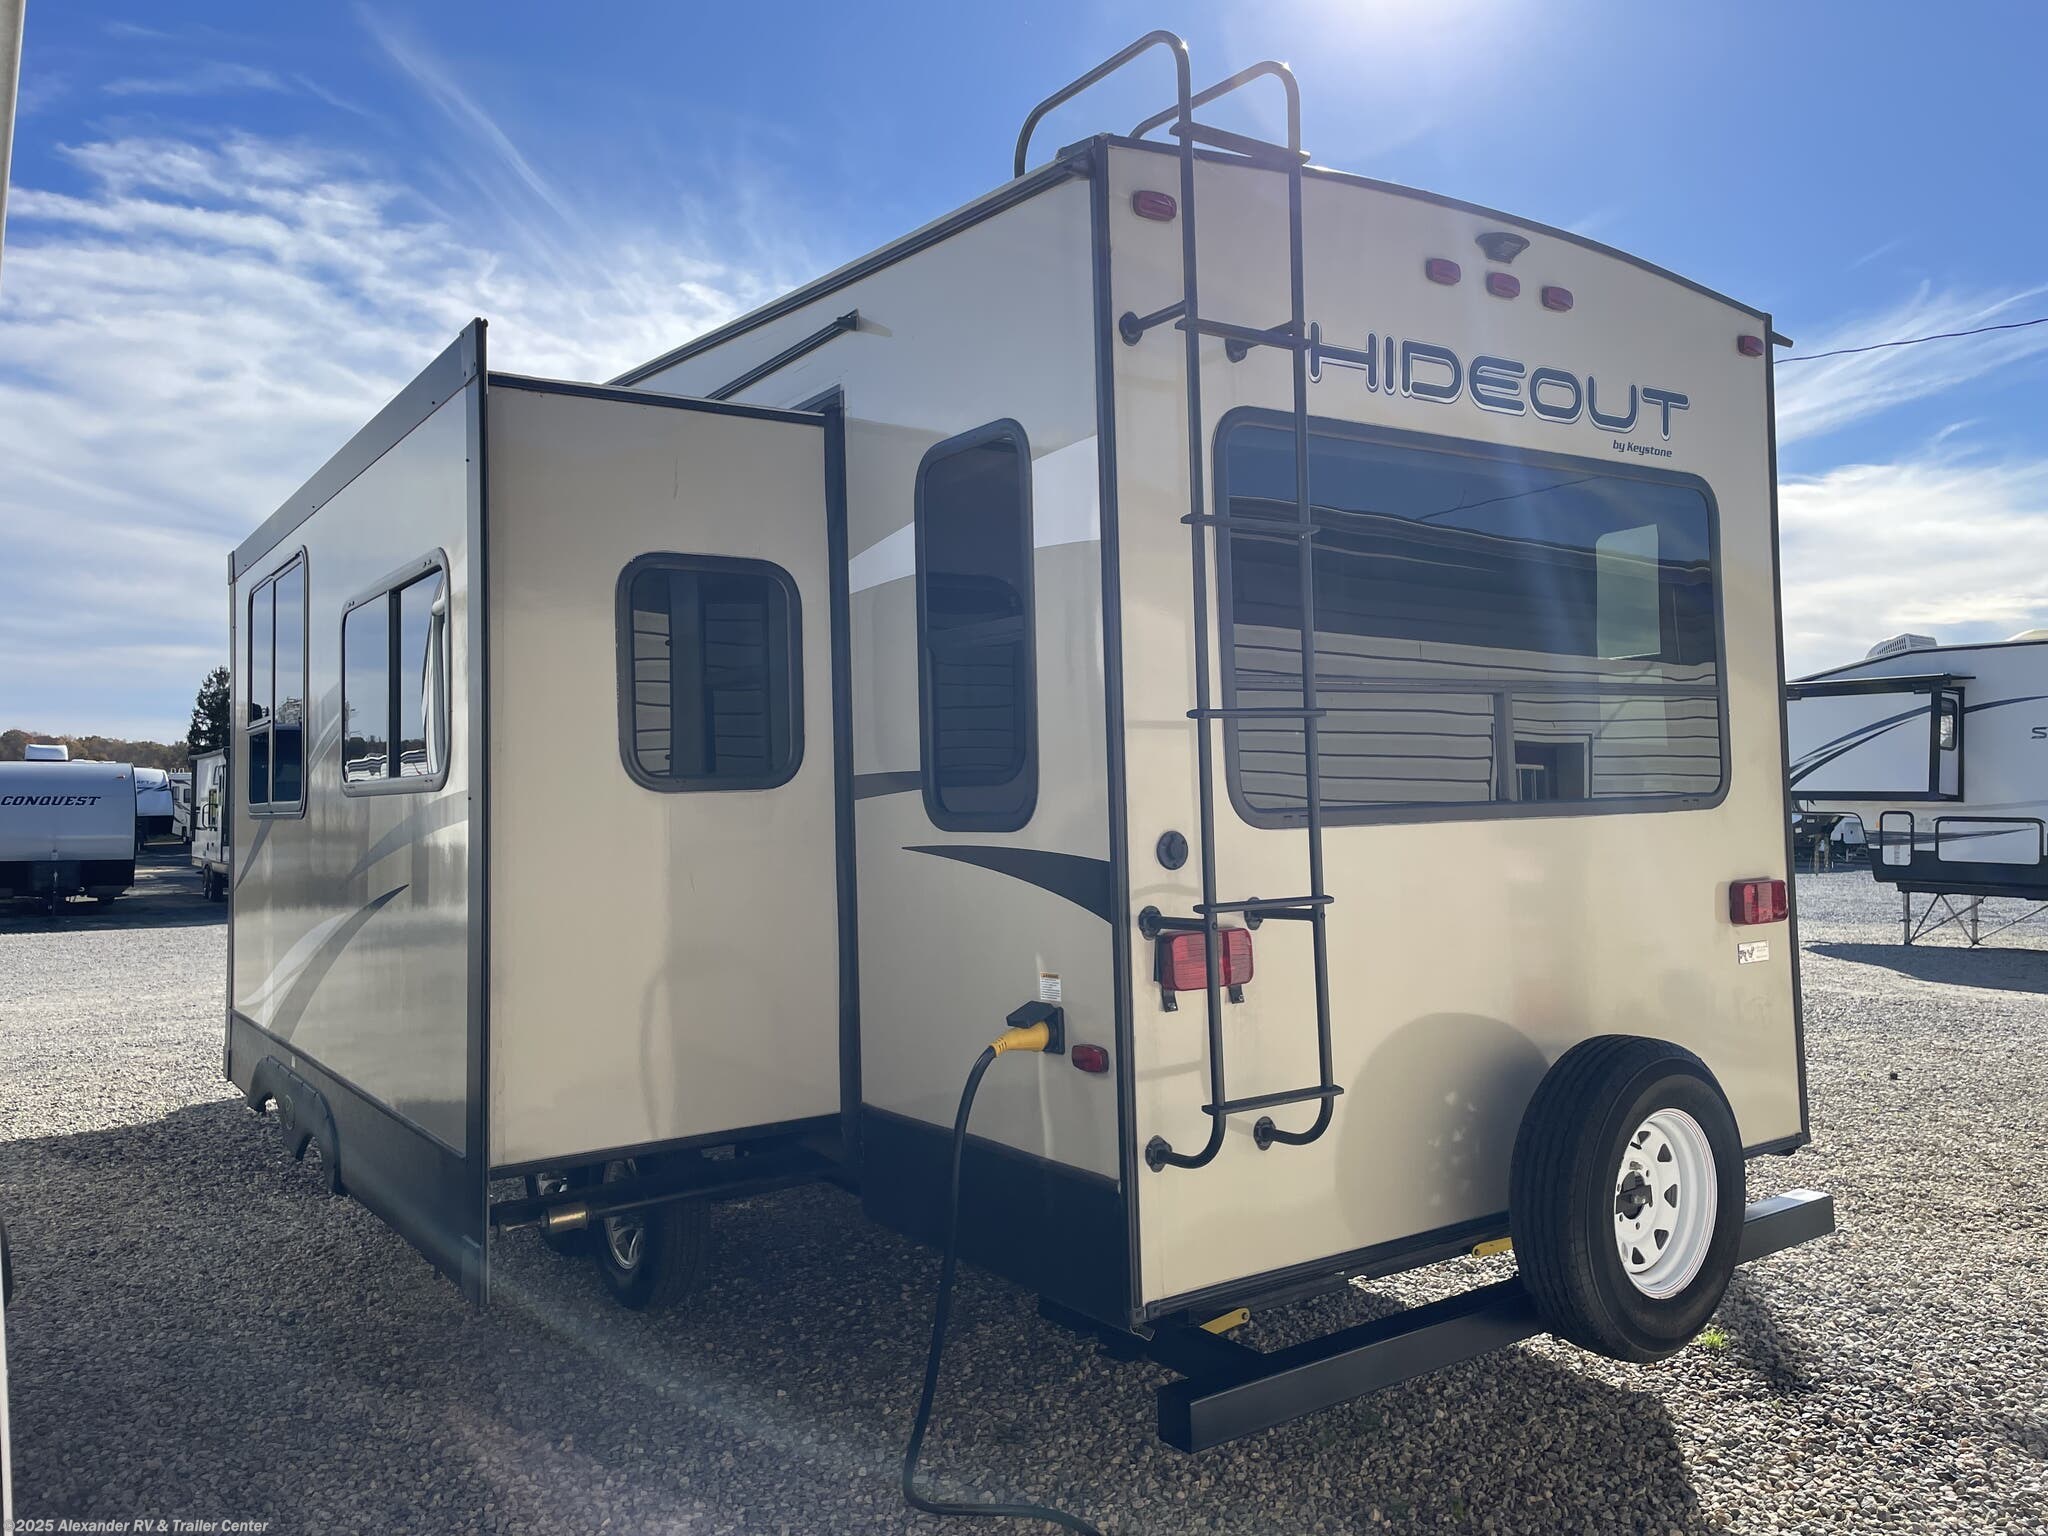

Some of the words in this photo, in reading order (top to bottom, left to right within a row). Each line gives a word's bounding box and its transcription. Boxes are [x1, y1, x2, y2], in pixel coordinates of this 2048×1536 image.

[1308, 320, 1690, 441] HIDEOUT
[1612, 439, 1626, 453] by
[1626, 441, 1673, 458] Keystone
[2031, 726, 2048, 739] S
[0, 795, 102, 806] CONQUEST
